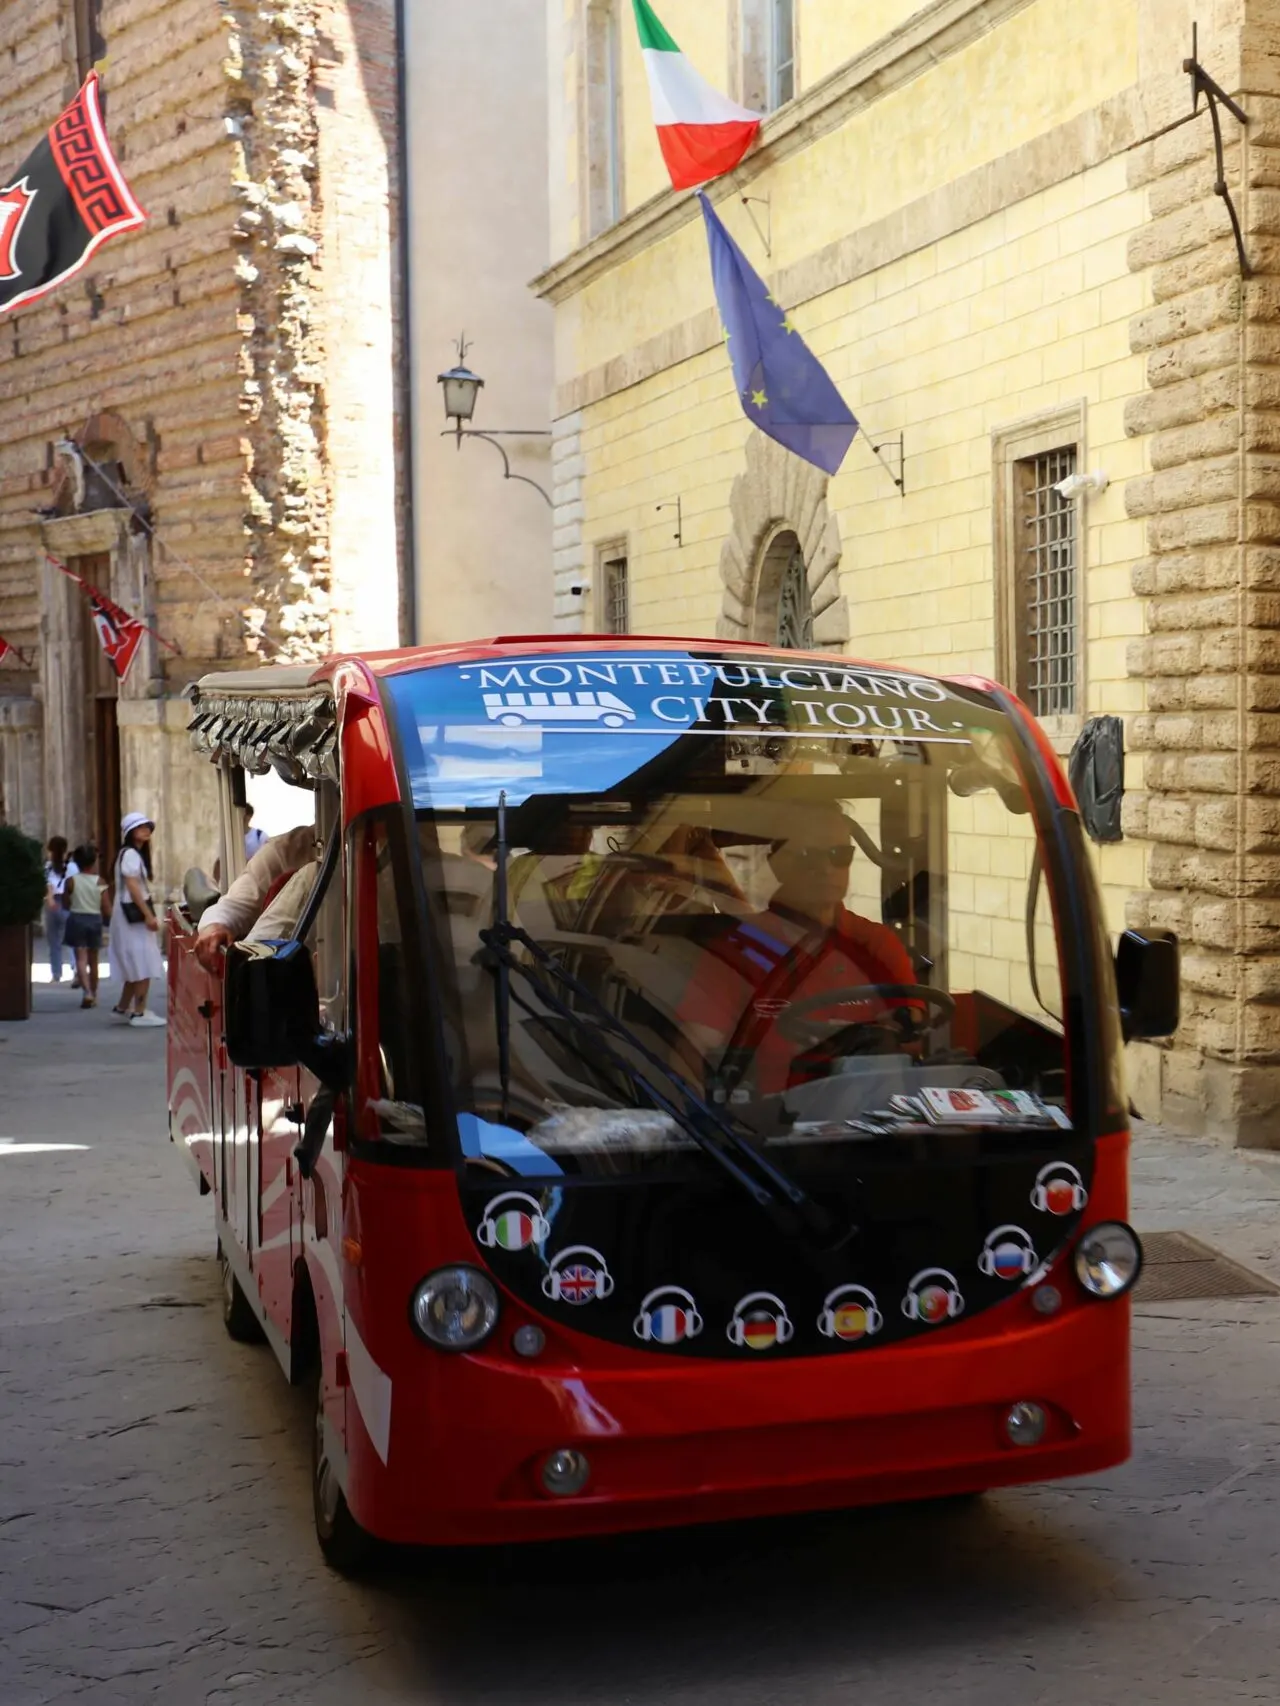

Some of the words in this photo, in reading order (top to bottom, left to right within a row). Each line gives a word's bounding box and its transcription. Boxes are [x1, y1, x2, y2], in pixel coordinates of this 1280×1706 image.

[478, 663, 948, 702] MONTEPULCIANO
[651, 696, 776, 724] CITY
[791, 701, 947, 732] TOUR
